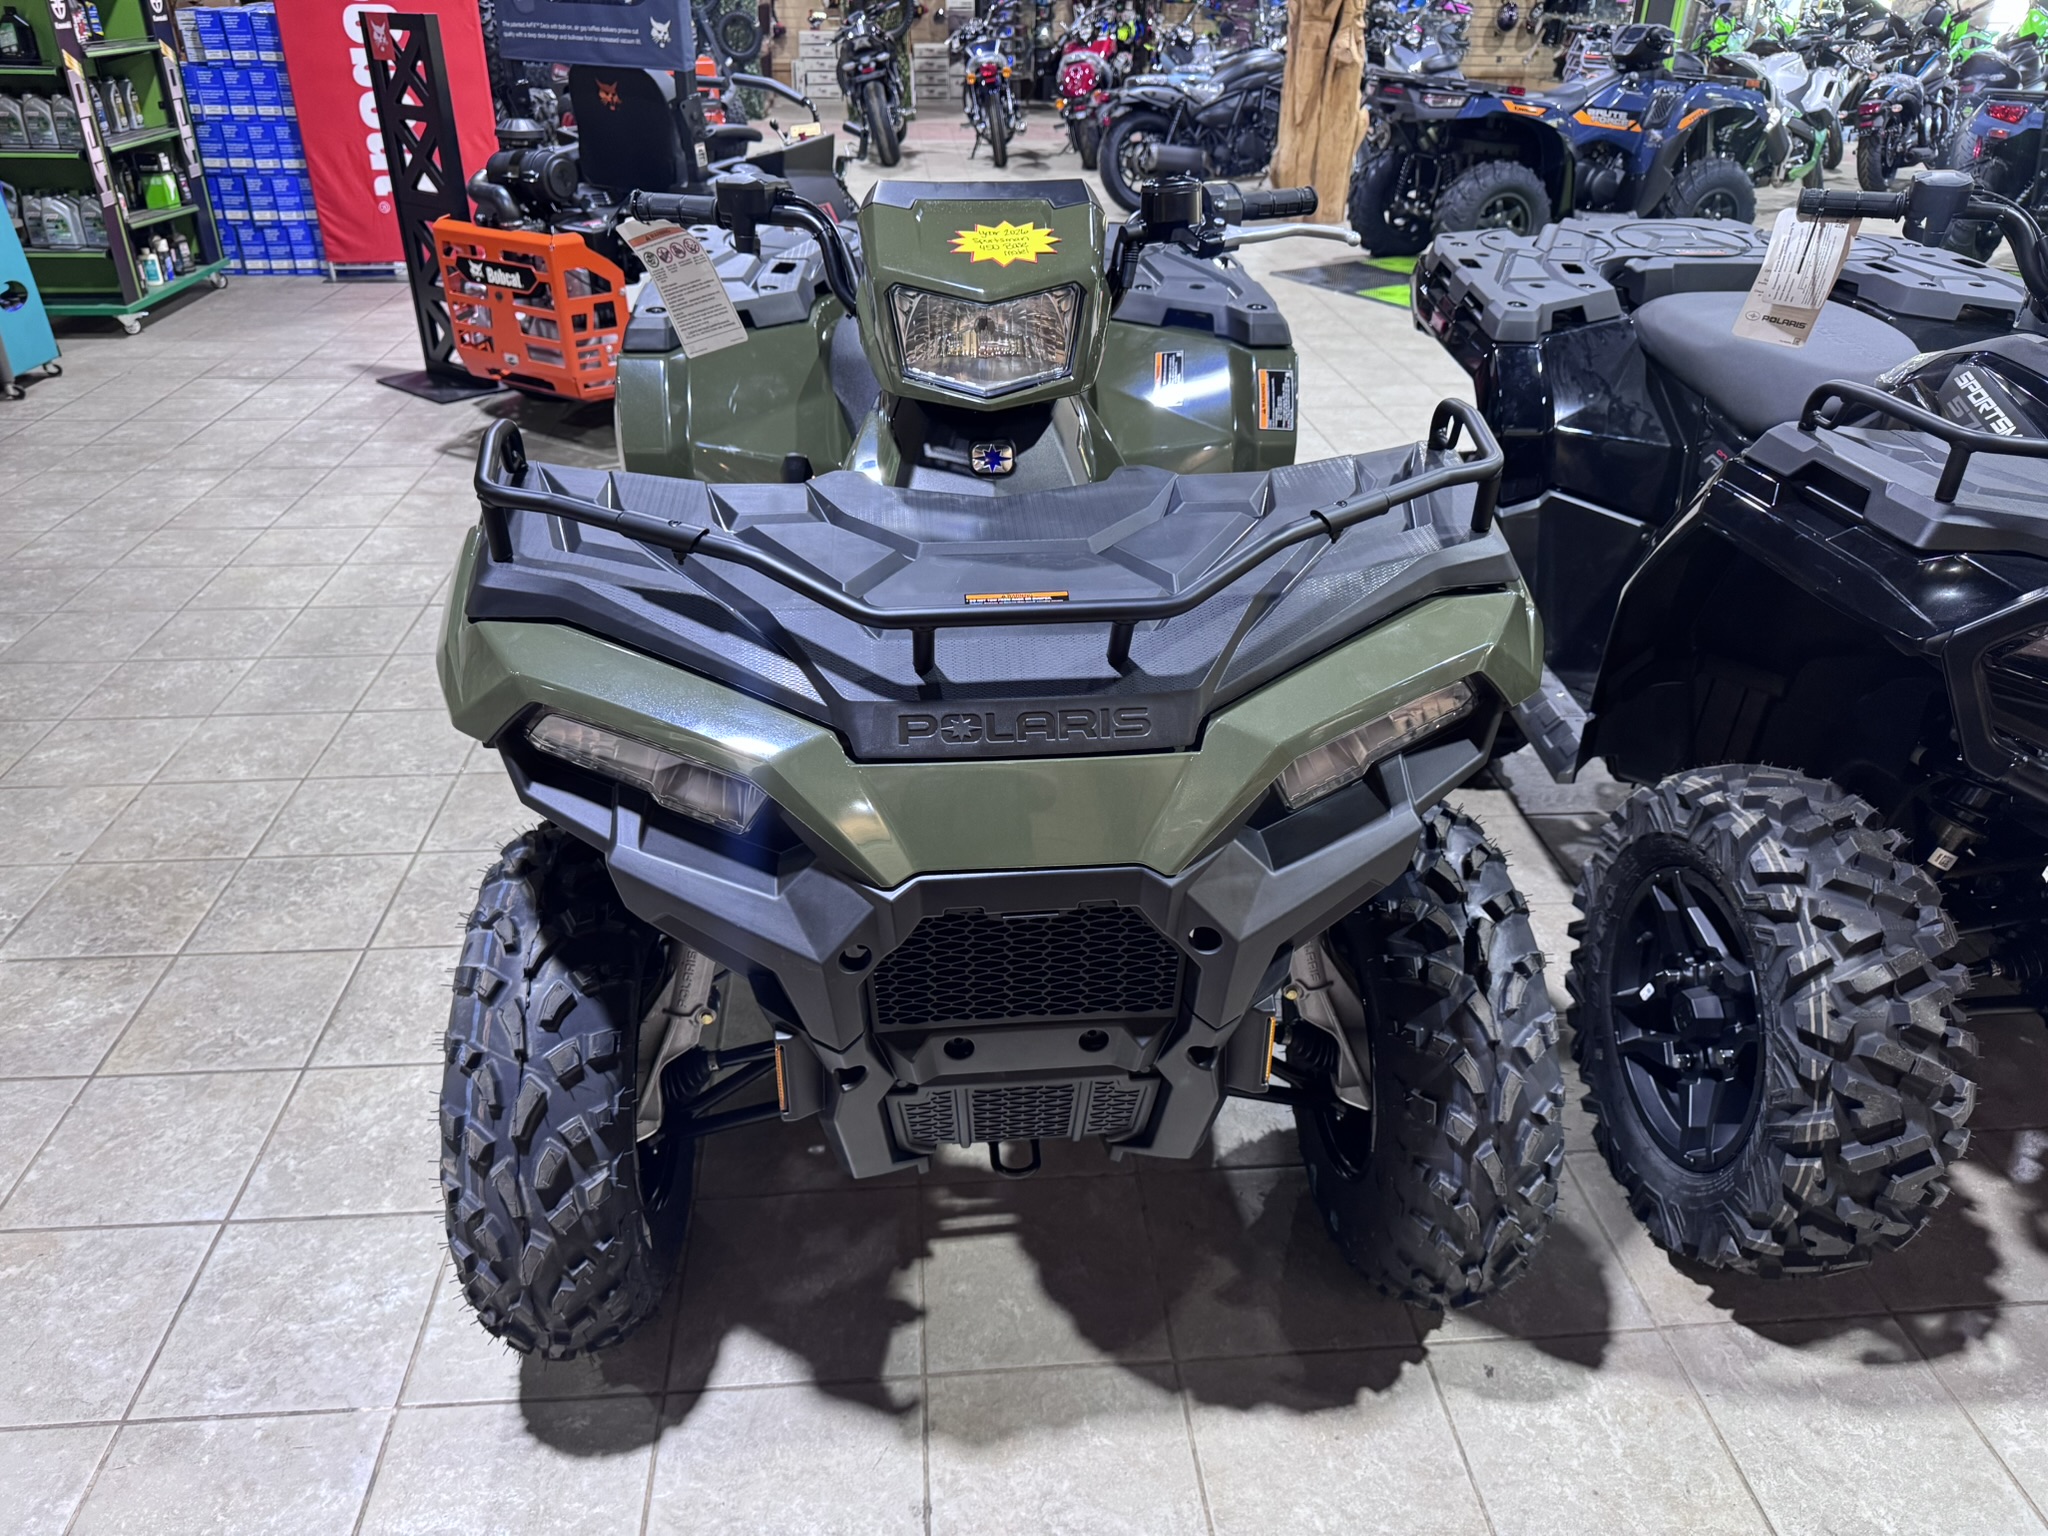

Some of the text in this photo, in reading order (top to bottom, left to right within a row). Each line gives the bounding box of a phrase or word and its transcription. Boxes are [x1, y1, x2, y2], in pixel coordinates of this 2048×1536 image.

[1587, 108, 1629, 119] BRUTE
[1591, 116, 1630, 127] FORCE
[485, 266, 523, 288] Bobcat
[1761, 314, 1808, 330] POLARIS
[1954, 371, 2023, 436] SPORTS
[898, 707, 1152, 746] POLARIS
[677, 949, 697, 1009] POLARIS
